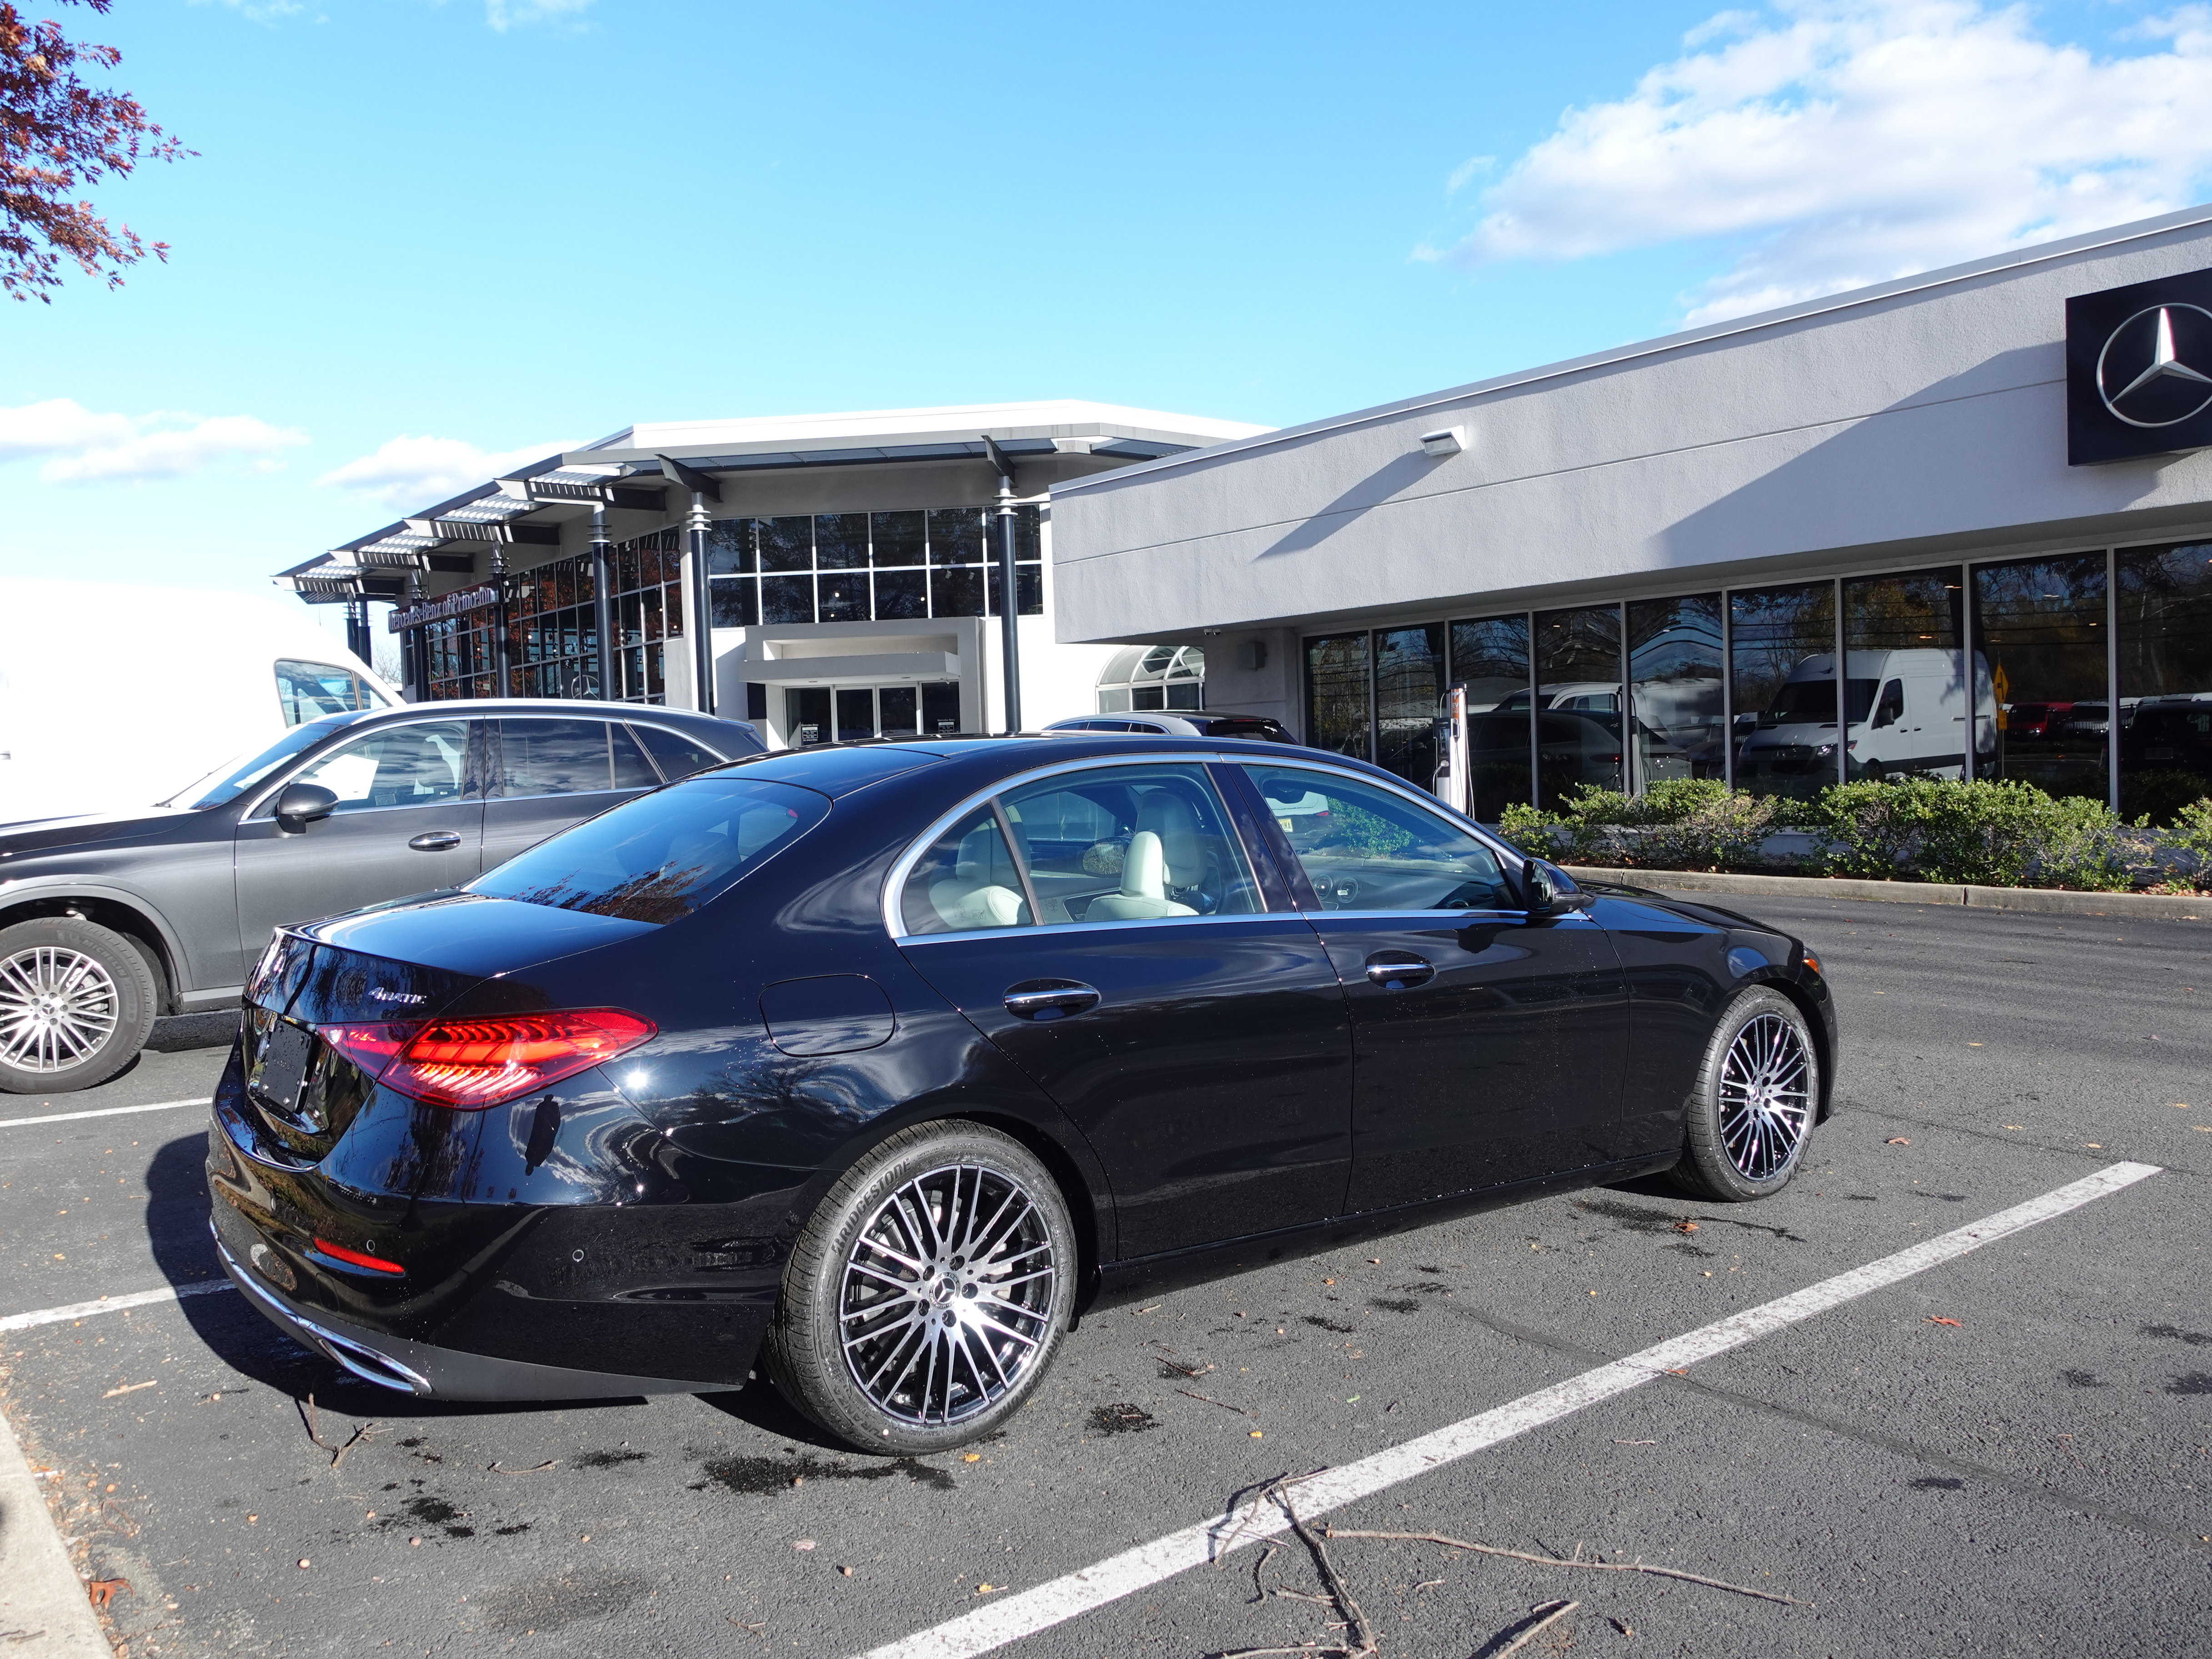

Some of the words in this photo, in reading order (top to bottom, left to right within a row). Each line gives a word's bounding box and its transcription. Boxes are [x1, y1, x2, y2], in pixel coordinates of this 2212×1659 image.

[388, 602, 441, 630] Mercedes-Benz
[442, 595, 452, 615] of
[452, 588, 493, 614] Princeton
[81, 939, 127, 977] MICHELIN
[368, 986, 427, 1004] 4MATIC
[1724, 1006, 1750, 1041] TURANZA
[831, 1158, 912, 1256] BRIDGESTONE
[995, 1326, 1064, 1422] BRIDGESTONE
